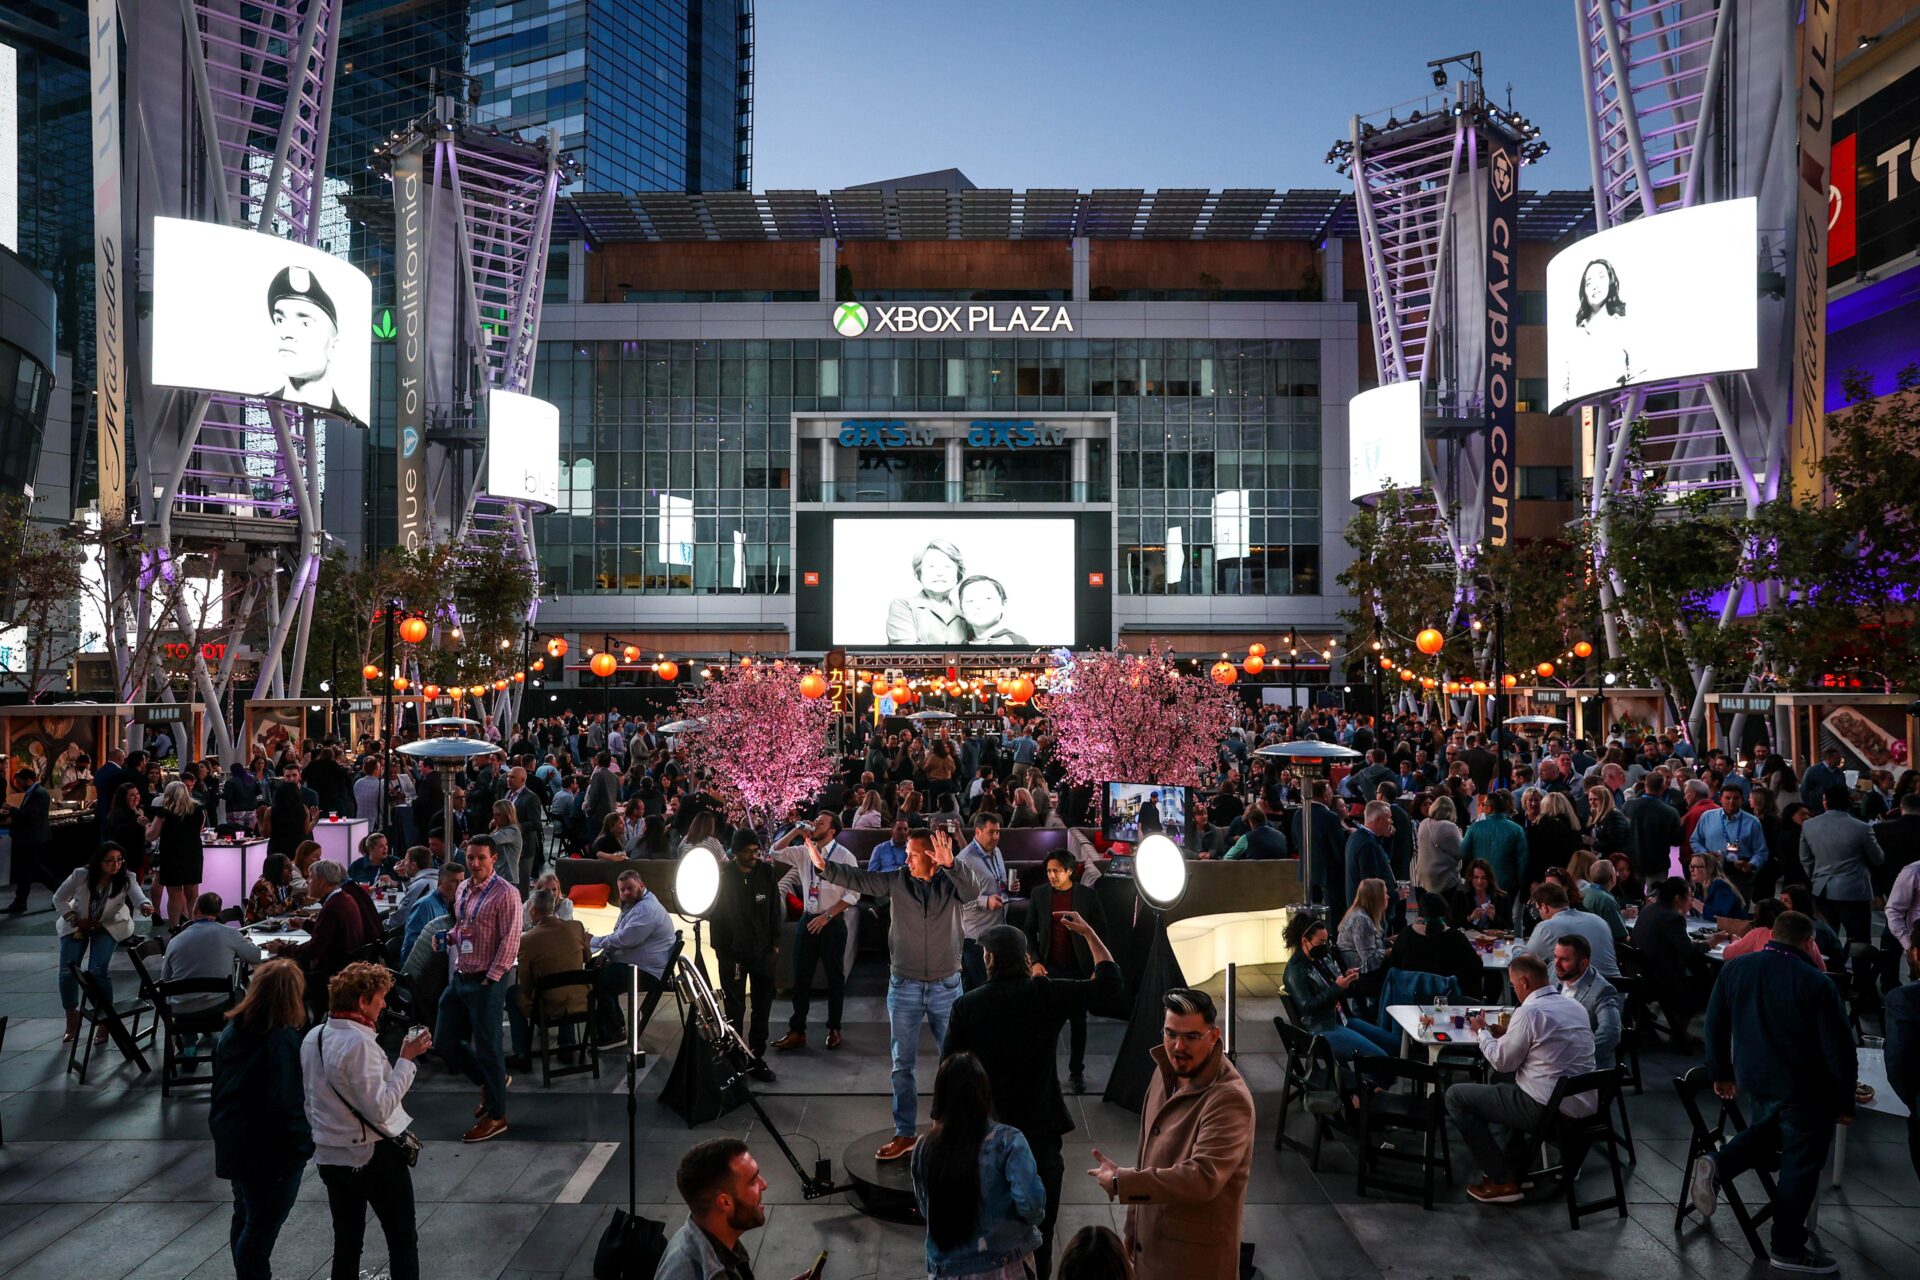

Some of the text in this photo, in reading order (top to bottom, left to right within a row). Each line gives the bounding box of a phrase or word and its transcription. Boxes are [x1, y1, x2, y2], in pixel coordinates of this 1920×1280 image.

[1876, 136, 1920, 202] T
[96, 0, 120, 491] Michelob ULT
[402, 173, 418, 362] california
[875, 306, 1073, 332] XBOX PLAZA
[1800, 203, 1820, 480] Michelob
[402, 377, 418, 414] of
[1488, 216, 1512, 547] crypto.com
[838, 420, 939, 451] axs.tv
[967, 420, 1067, 451] axs.tv
[164, 642, 240, 660] TOOT
[830, 668, 843, 713] カフェ
[148, 708, 180, 720] RAMEN
